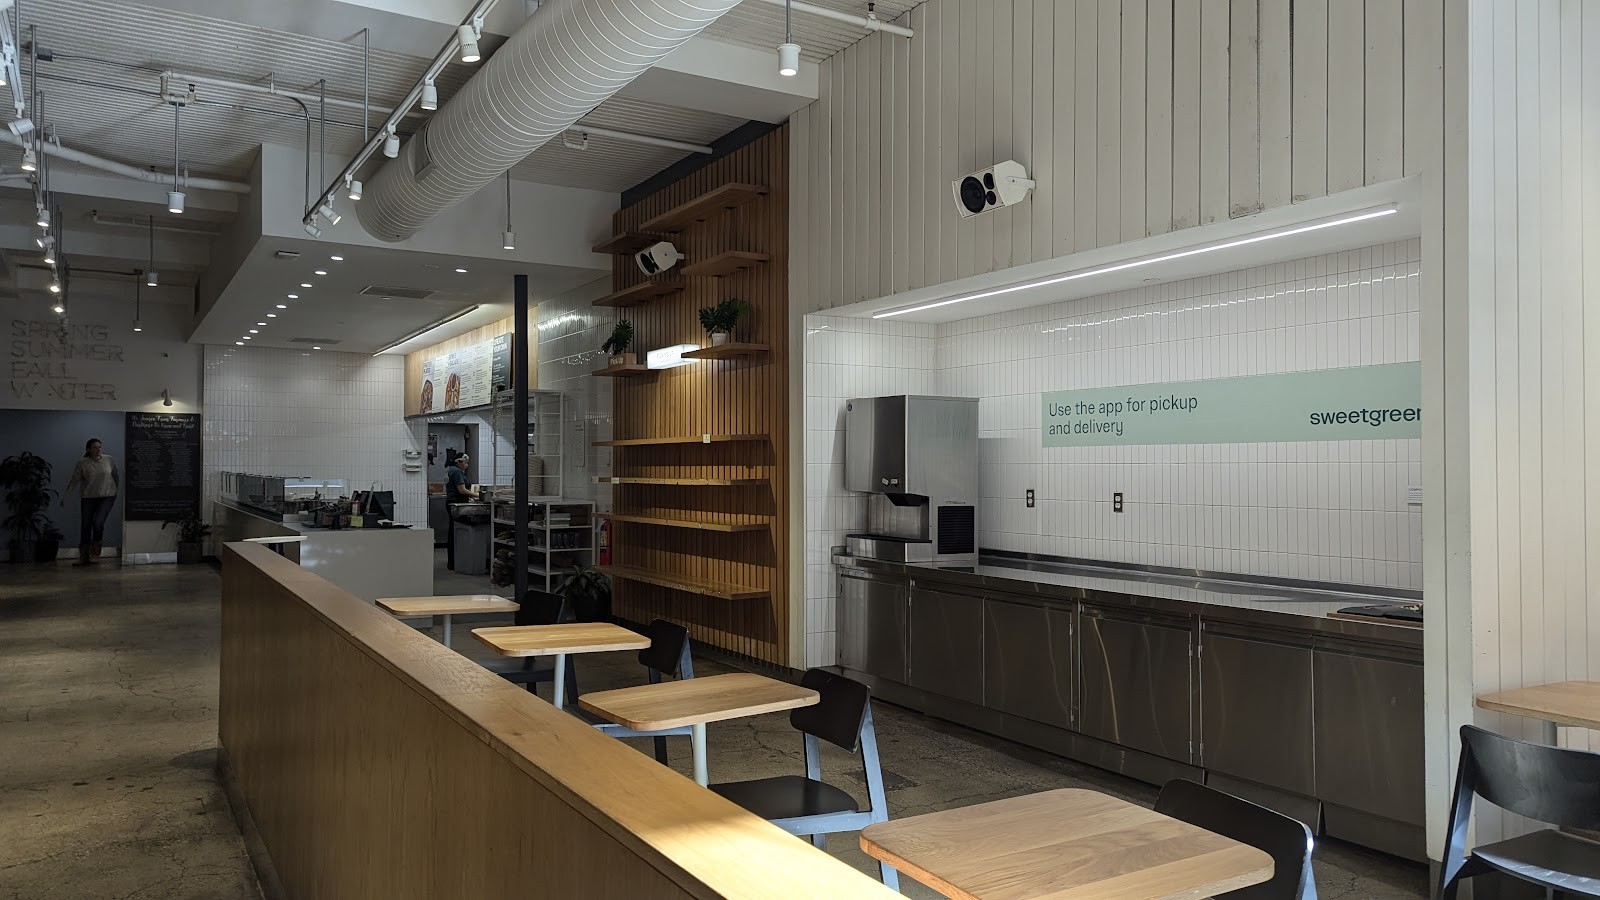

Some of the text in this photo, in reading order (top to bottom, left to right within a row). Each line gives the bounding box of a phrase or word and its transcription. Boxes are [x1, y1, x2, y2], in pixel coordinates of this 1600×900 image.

[11, 340, 124, 362] SUMMER
[11, 361, 76, 380] FALL
[10, 381, 117, 401] WNTER
[1049, 395, 1198, 417] Use the app for pickup
[1049, 419, 1123, 437] and delivery
